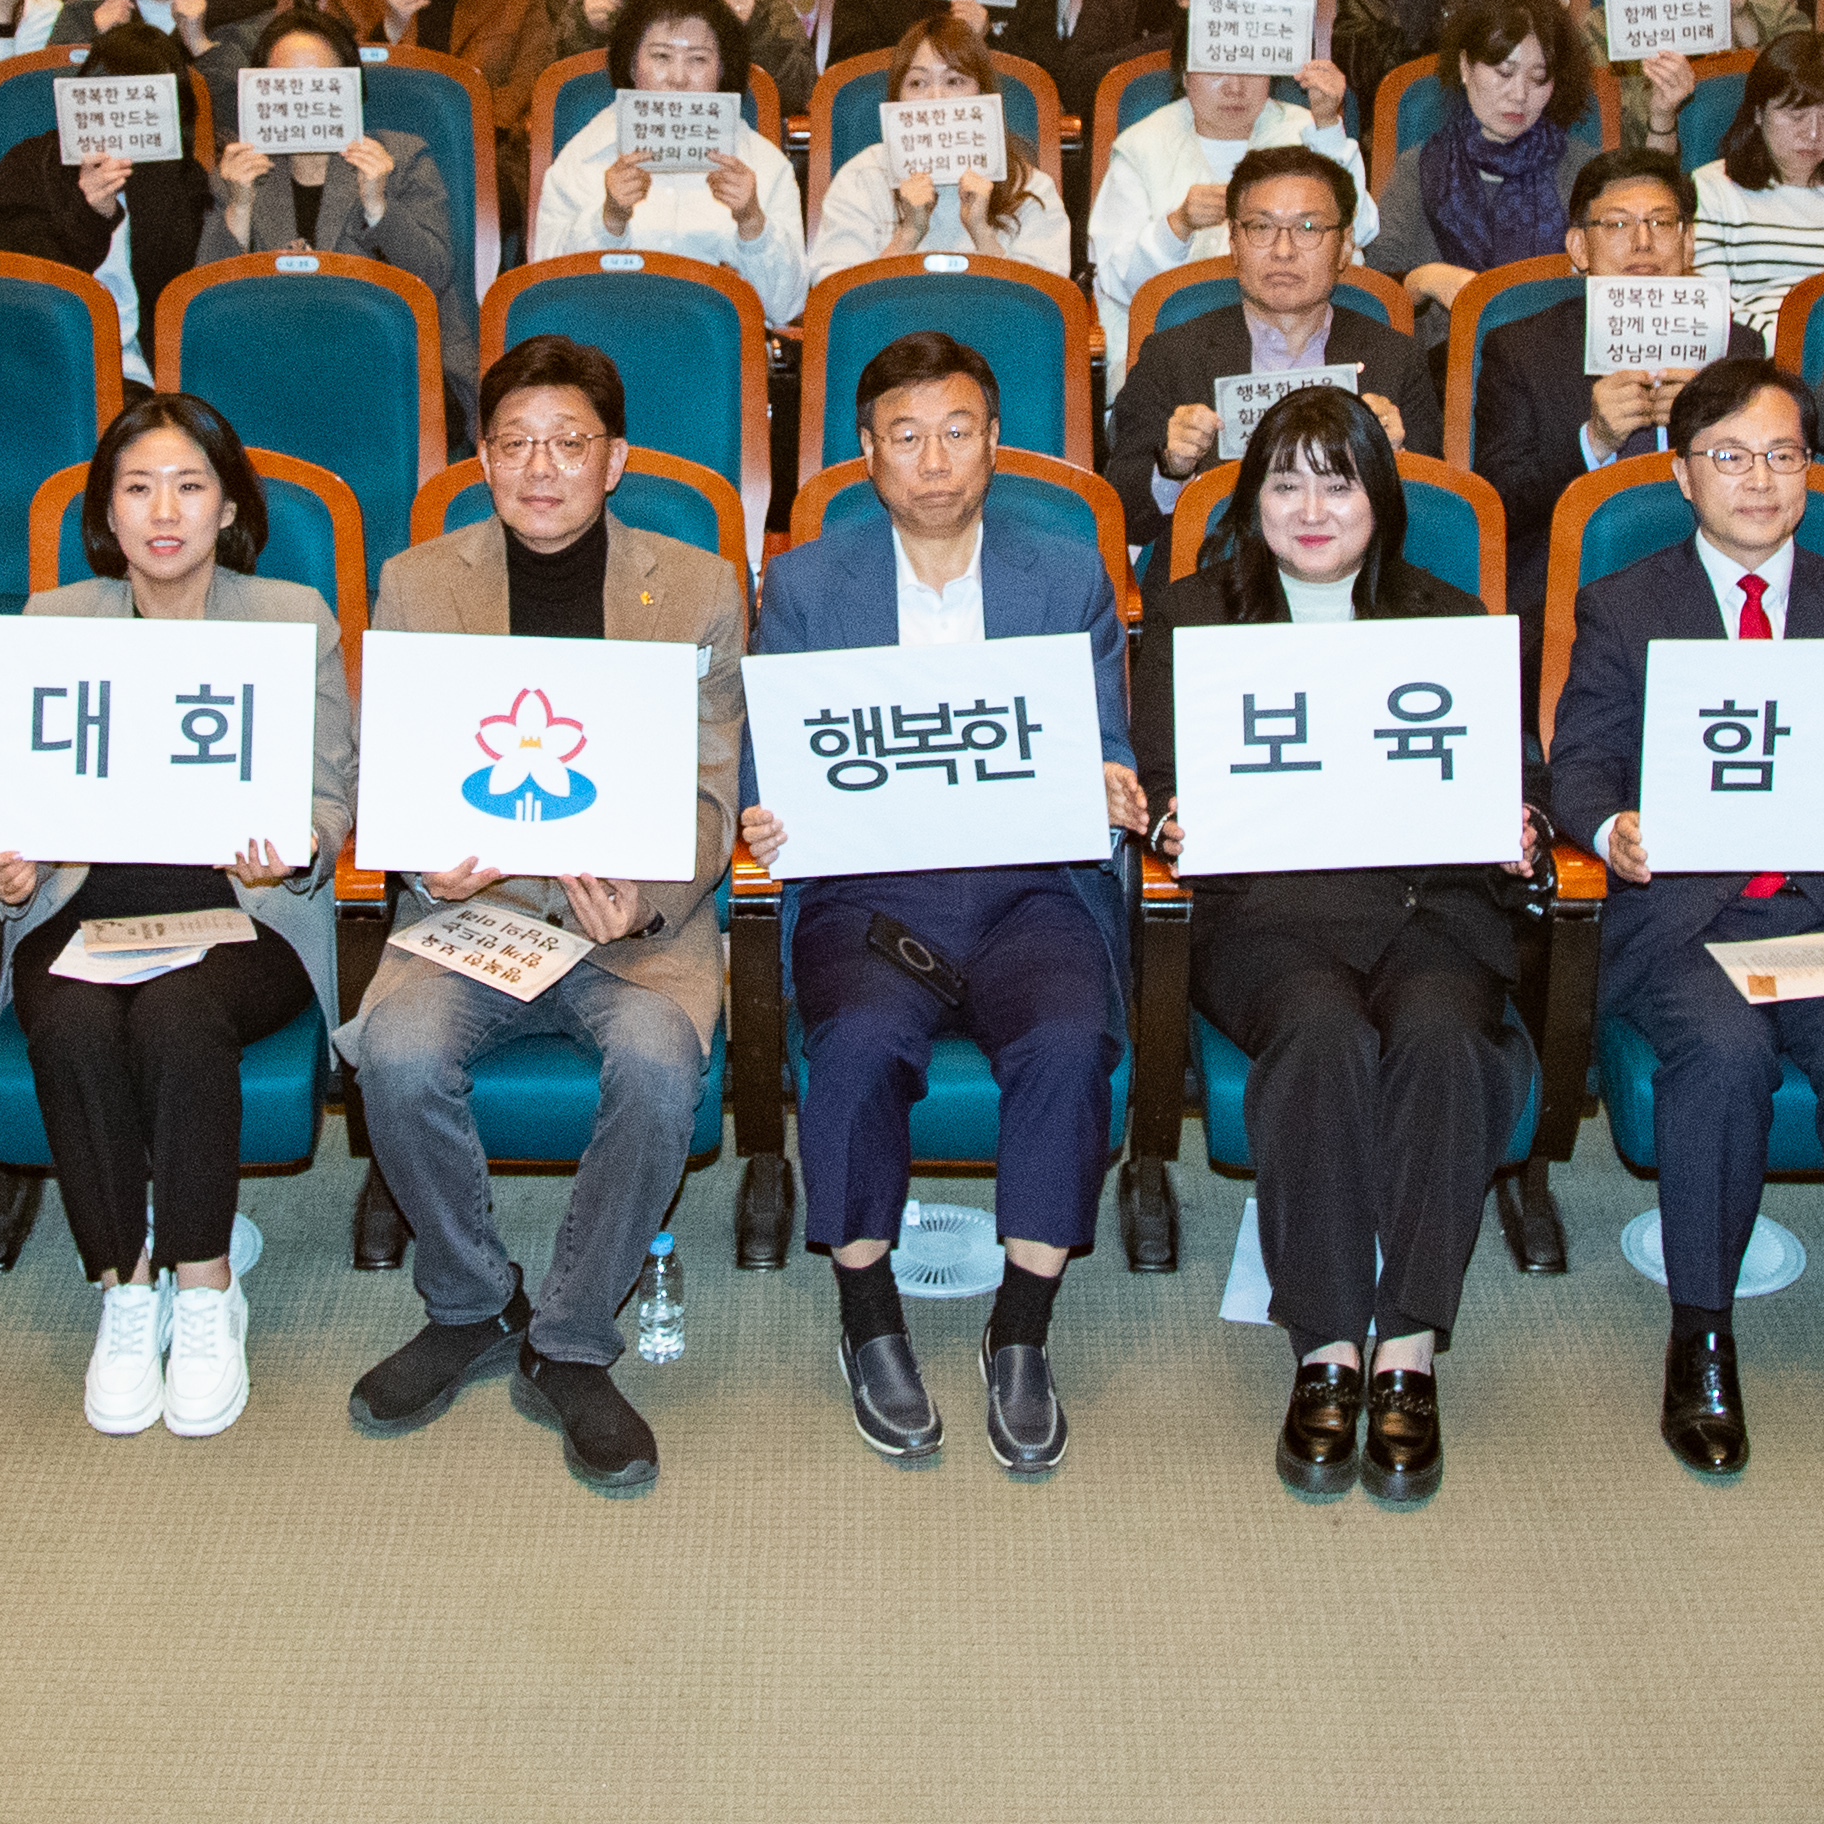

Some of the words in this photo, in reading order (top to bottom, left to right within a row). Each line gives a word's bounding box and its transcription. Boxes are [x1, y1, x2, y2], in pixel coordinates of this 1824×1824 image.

[1624, 5, 1657, 24] 함께
[1662, 1, 1712, 21] 만드는
[1626, 28, 1675, 48] 성남의
[1681, 24, 1714, 40] 미래
[71, 87, 119, 105] 행복한
[126, 85, 156, 102] 보육
[255, 78, 304, 95] 행복한
[311, 78, 341, 94] 보육
[74, 111, 105, 129] 함께
[110, 110, 159, 128] 만드는
[256, 101, 289, 119] 함께
[294, 102, 342, 119] 만드는
[898, 108, 946, 127] 행복한
[953, 106, 983, 122] 보육
[76, 135, 123, 152] 성남의
[129, 133, 162, 148] 미래
[257, 125, 305, 142] 성남의
[312, 124, 344, 139] 미래
[901, 133, 933, 152] 함께
[937, 131, 985, 149] 만드는
[903, 156, 950, 175] 성남의
[956, 153, 988, 168] 미래
[1607, 287, 1664, 308] 행복한
[1672, 289, 1707, 308] 보육
[1607, 315, 1645, 336] 함께
[1651, 317, 1706, 336] 만드는
[1607, 344, 1662, 363] 성남의
[1670, 343, 1706, 360] 미래
[805, 697, 1041, 791] 행복한
